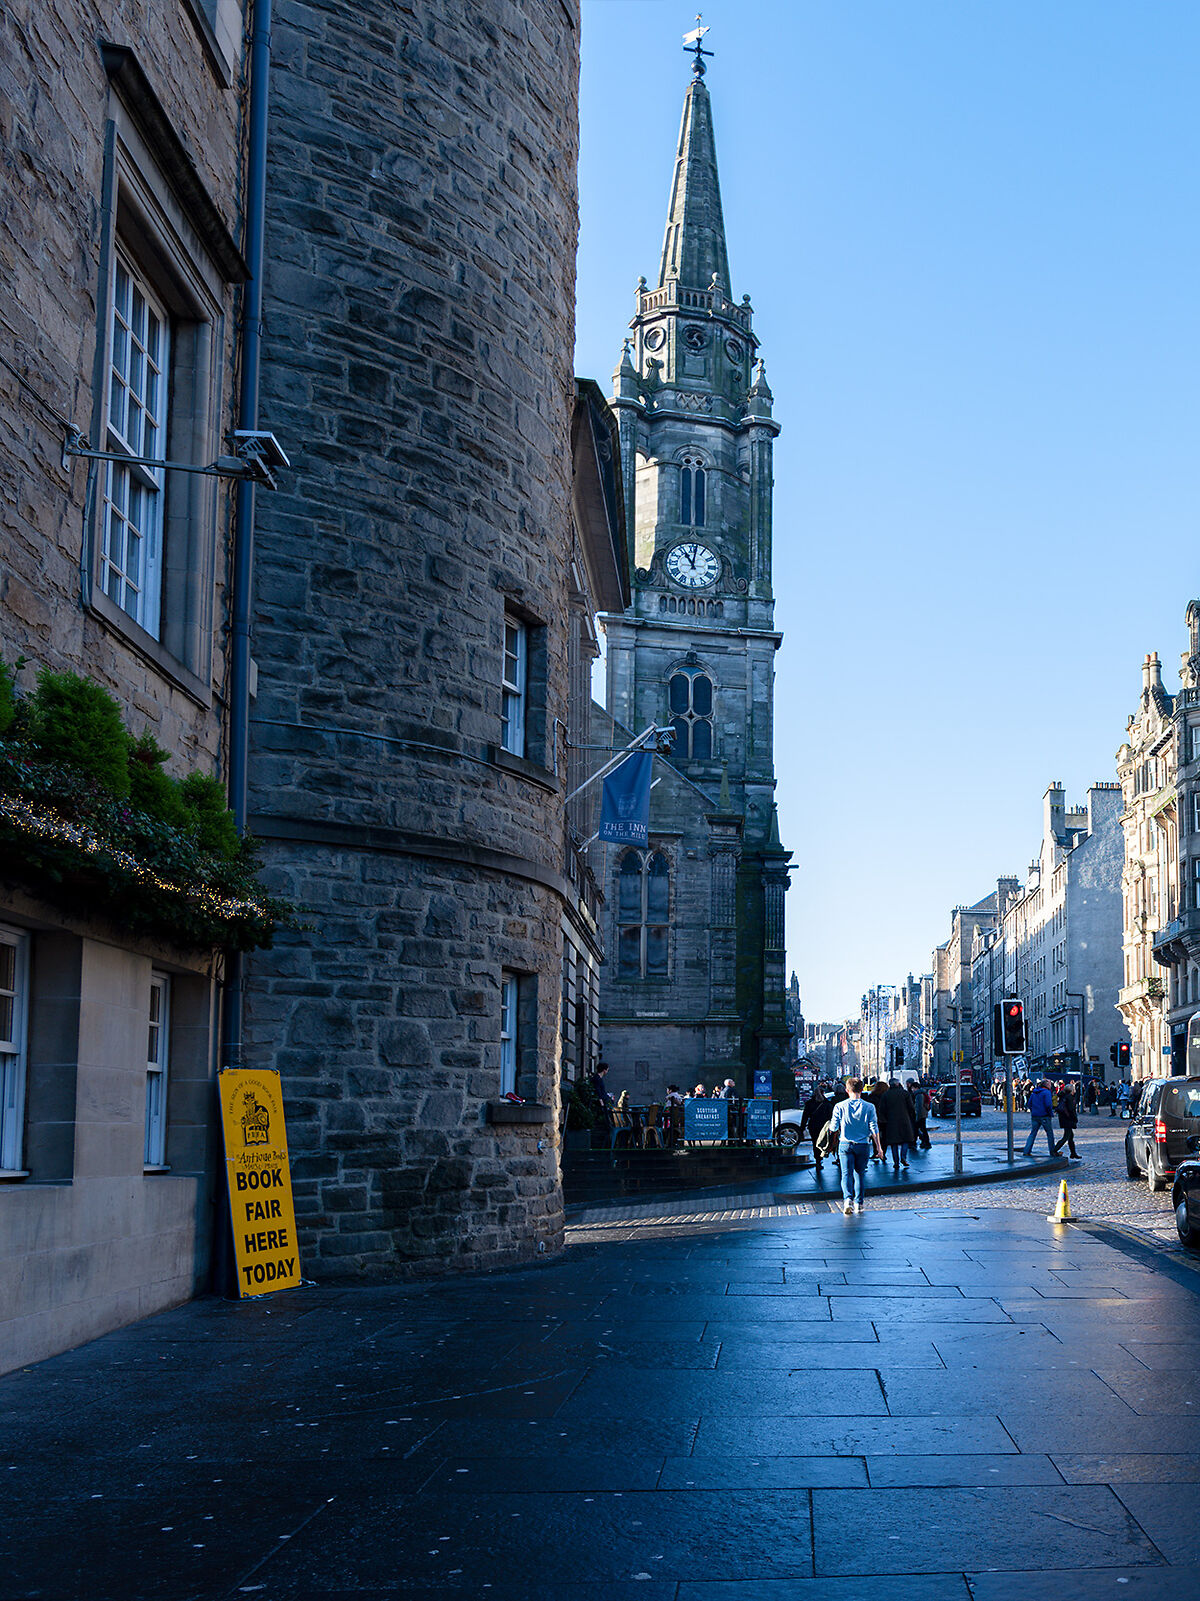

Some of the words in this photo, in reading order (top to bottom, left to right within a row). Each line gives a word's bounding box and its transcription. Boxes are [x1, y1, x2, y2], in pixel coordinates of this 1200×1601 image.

[604, 821, 624, 831] THE
[629, 822, 646, 833] INN
[631, 832, 646, 840] MILE
[236, 1168, 284, 1191] BOOK
[245, 1199, 282, 1221] FAIR
[244, 1229, 289, 1253] HERE
[242, 1257, 295, 1286] TODAY
